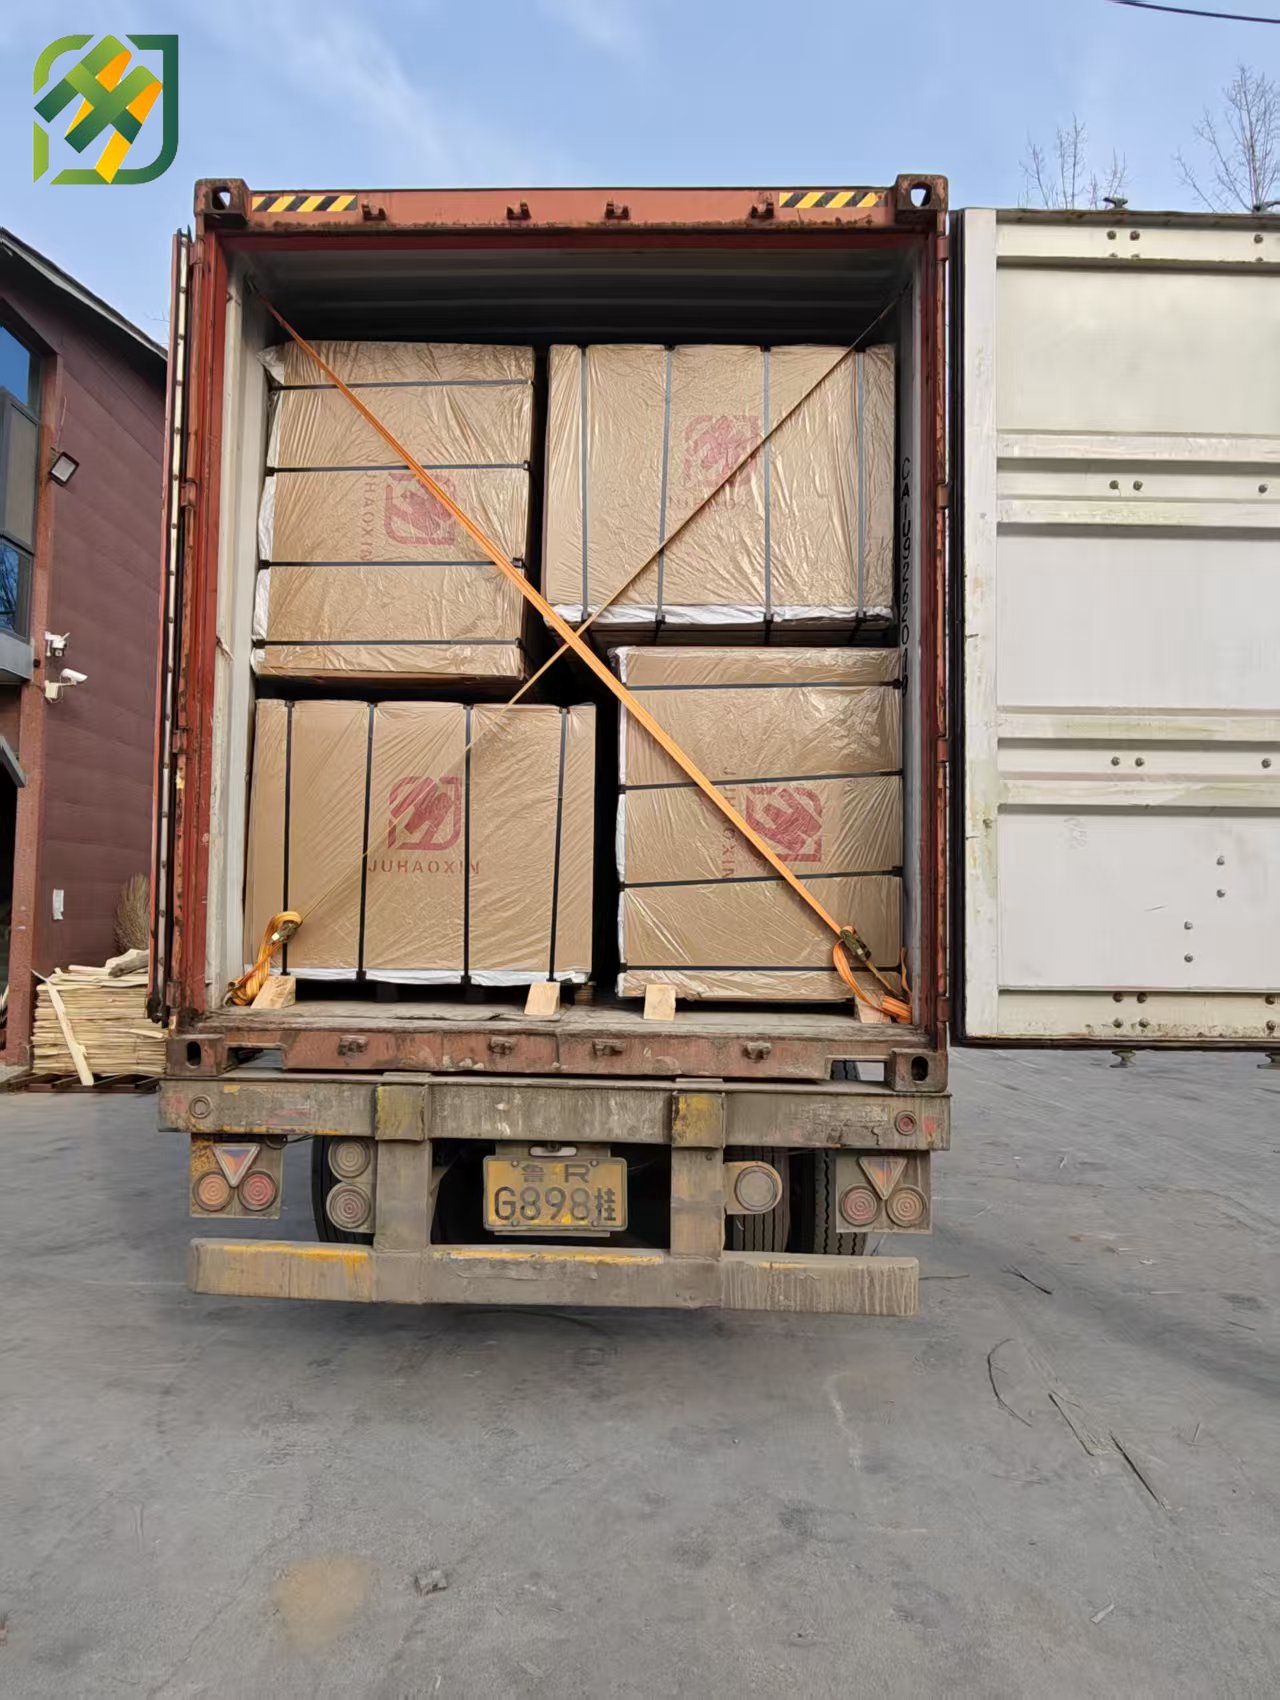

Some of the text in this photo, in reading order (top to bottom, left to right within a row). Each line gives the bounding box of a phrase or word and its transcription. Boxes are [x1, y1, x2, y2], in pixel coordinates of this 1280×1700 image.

[722, 767, 737, 878] JUOXIN
[367, 859, 480, 875] JUHAOXIN
[494, 1186, 618, 1222] G898挂
